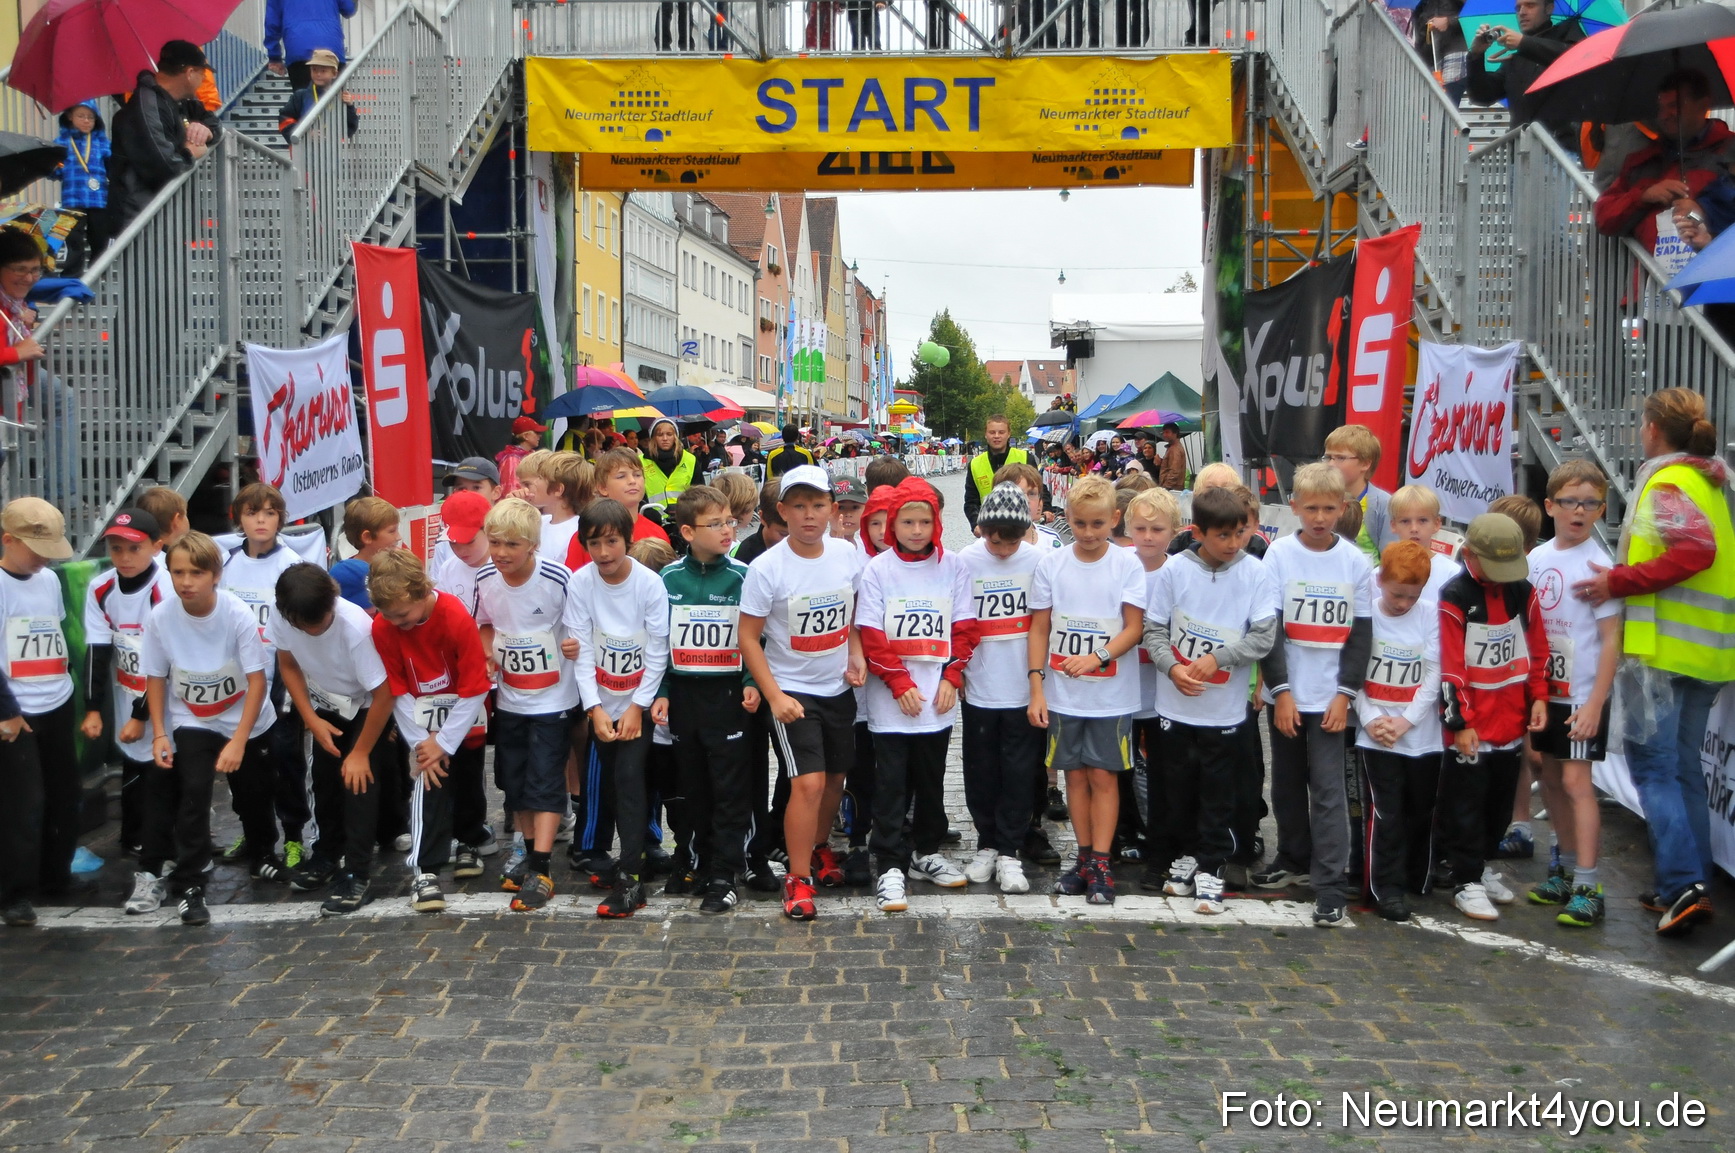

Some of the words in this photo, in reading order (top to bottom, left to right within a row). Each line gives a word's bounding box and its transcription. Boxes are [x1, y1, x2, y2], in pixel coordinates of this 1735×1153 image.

[564, 108, 647, 122] Neumarkter
[651, 109, 713, 122] Stadtlauf
[755, 77, 996, 134] START
[1039, 107, 1121, 121] Neumarkter
[1126, 106, 1190, 119] Stadtlauf
[610, 154, 681, 166] Neumarkter
[683, 154, 741, 166] Stadtlauf
[1032, 151, 1106, 164] Neumarkter
[1109, 149, 1163, 161] Stadtlauf
[974, 591, 1028, 618] 7294
[1292, 598, 1348, 624] 7180
[797, 604, 846, 635] 7321
[893, 613, 944, 638] 7234
[17, 633, 63, 658] 7176
[678, 623, 734, 647] 7007
[1178, 626, 1225, 659] 713
[498, 648, 548, 672] 7351
[600, 645, 642, 674] 7125
[679, 651, 733, 664] Constantin
[1474, 634, 1516, 666] 7367
[1370, 656, 1422, 685] 7170
[180, 676, 237, 703] 7270
